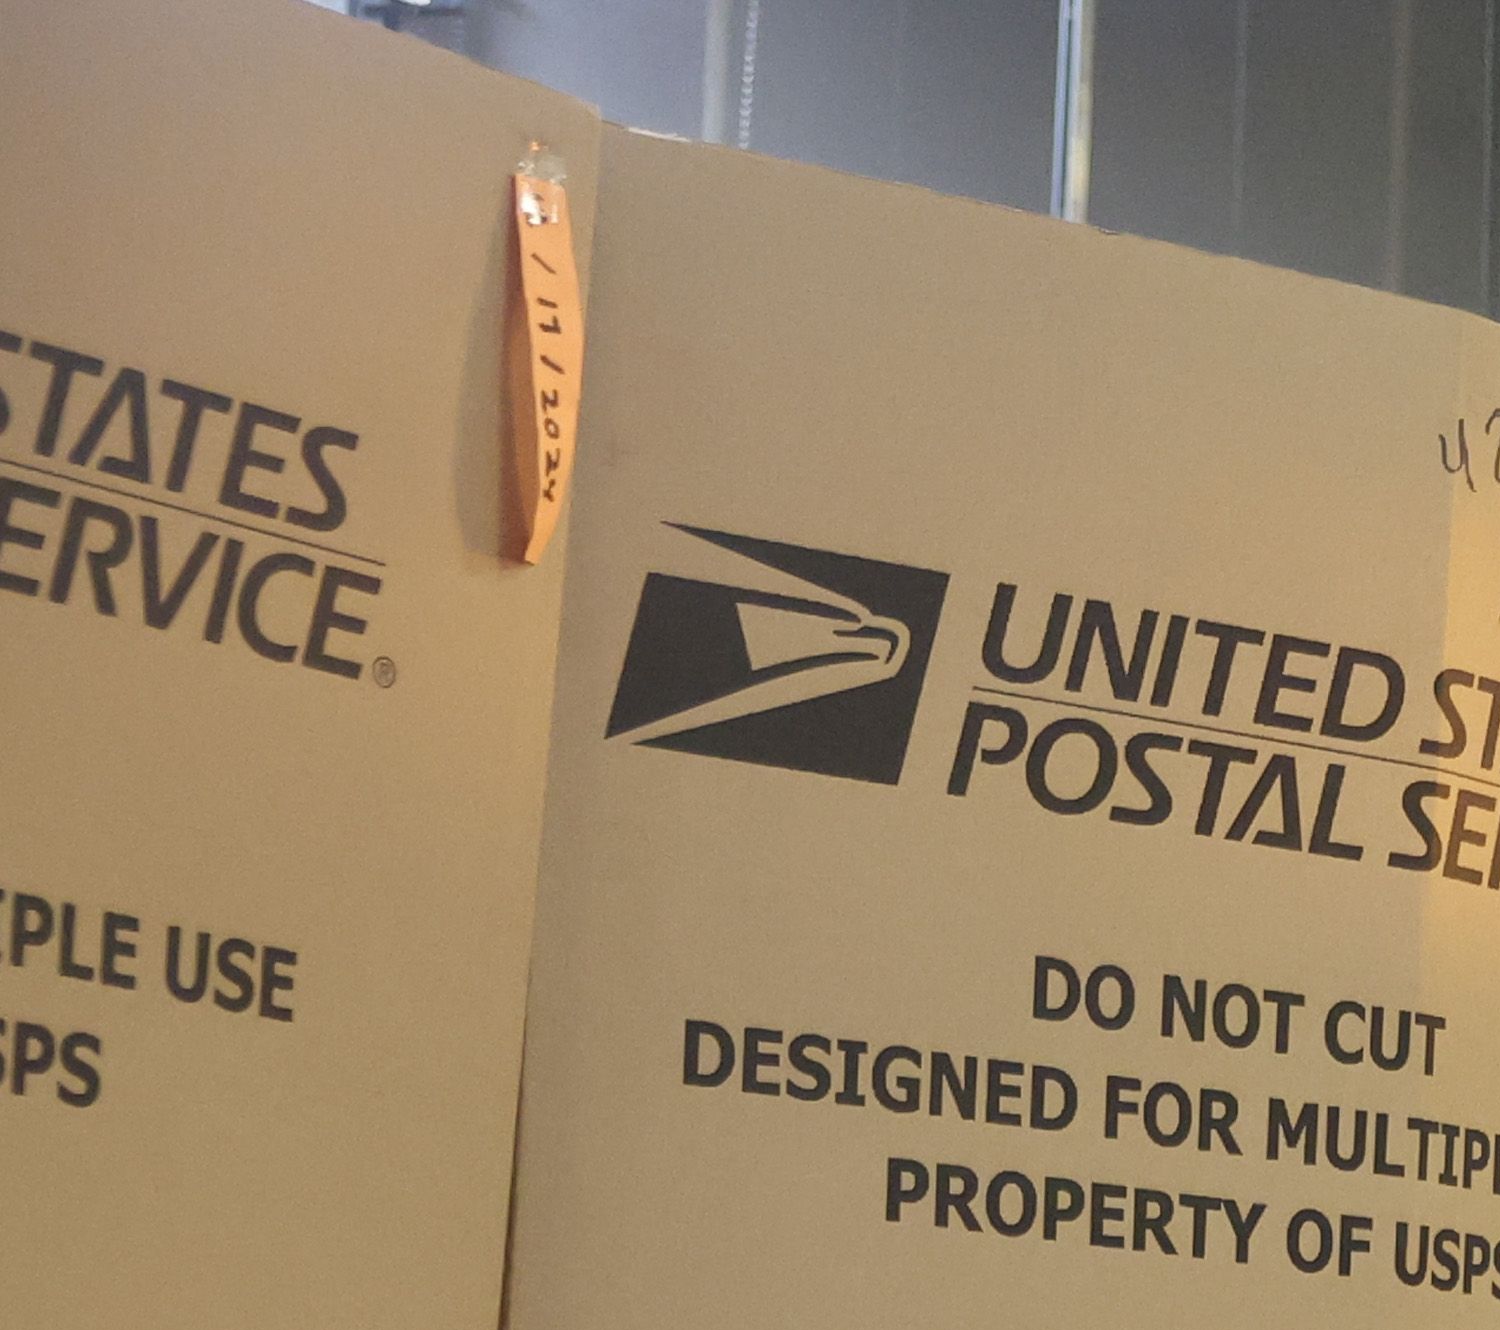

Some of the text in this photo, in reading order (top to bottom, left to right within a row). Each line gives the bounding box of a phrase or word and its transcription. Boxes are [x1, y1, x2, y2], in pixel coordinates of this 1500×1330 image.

[977, 580, 1408, 744] UNITED
[945, 698, 1365, 863] POSTAL
[165, 924, 298, 1024] USE
[1031, 952, 1447, 1078] DO NOT CUT
[681, 1018, 1080, 1132] DESIGNED
[1102, 1076, 1243, 1157] FOR
[883, 1157, 1266, 1266] PROPERTY
[1286, 1209, 1372, 1279] OF
